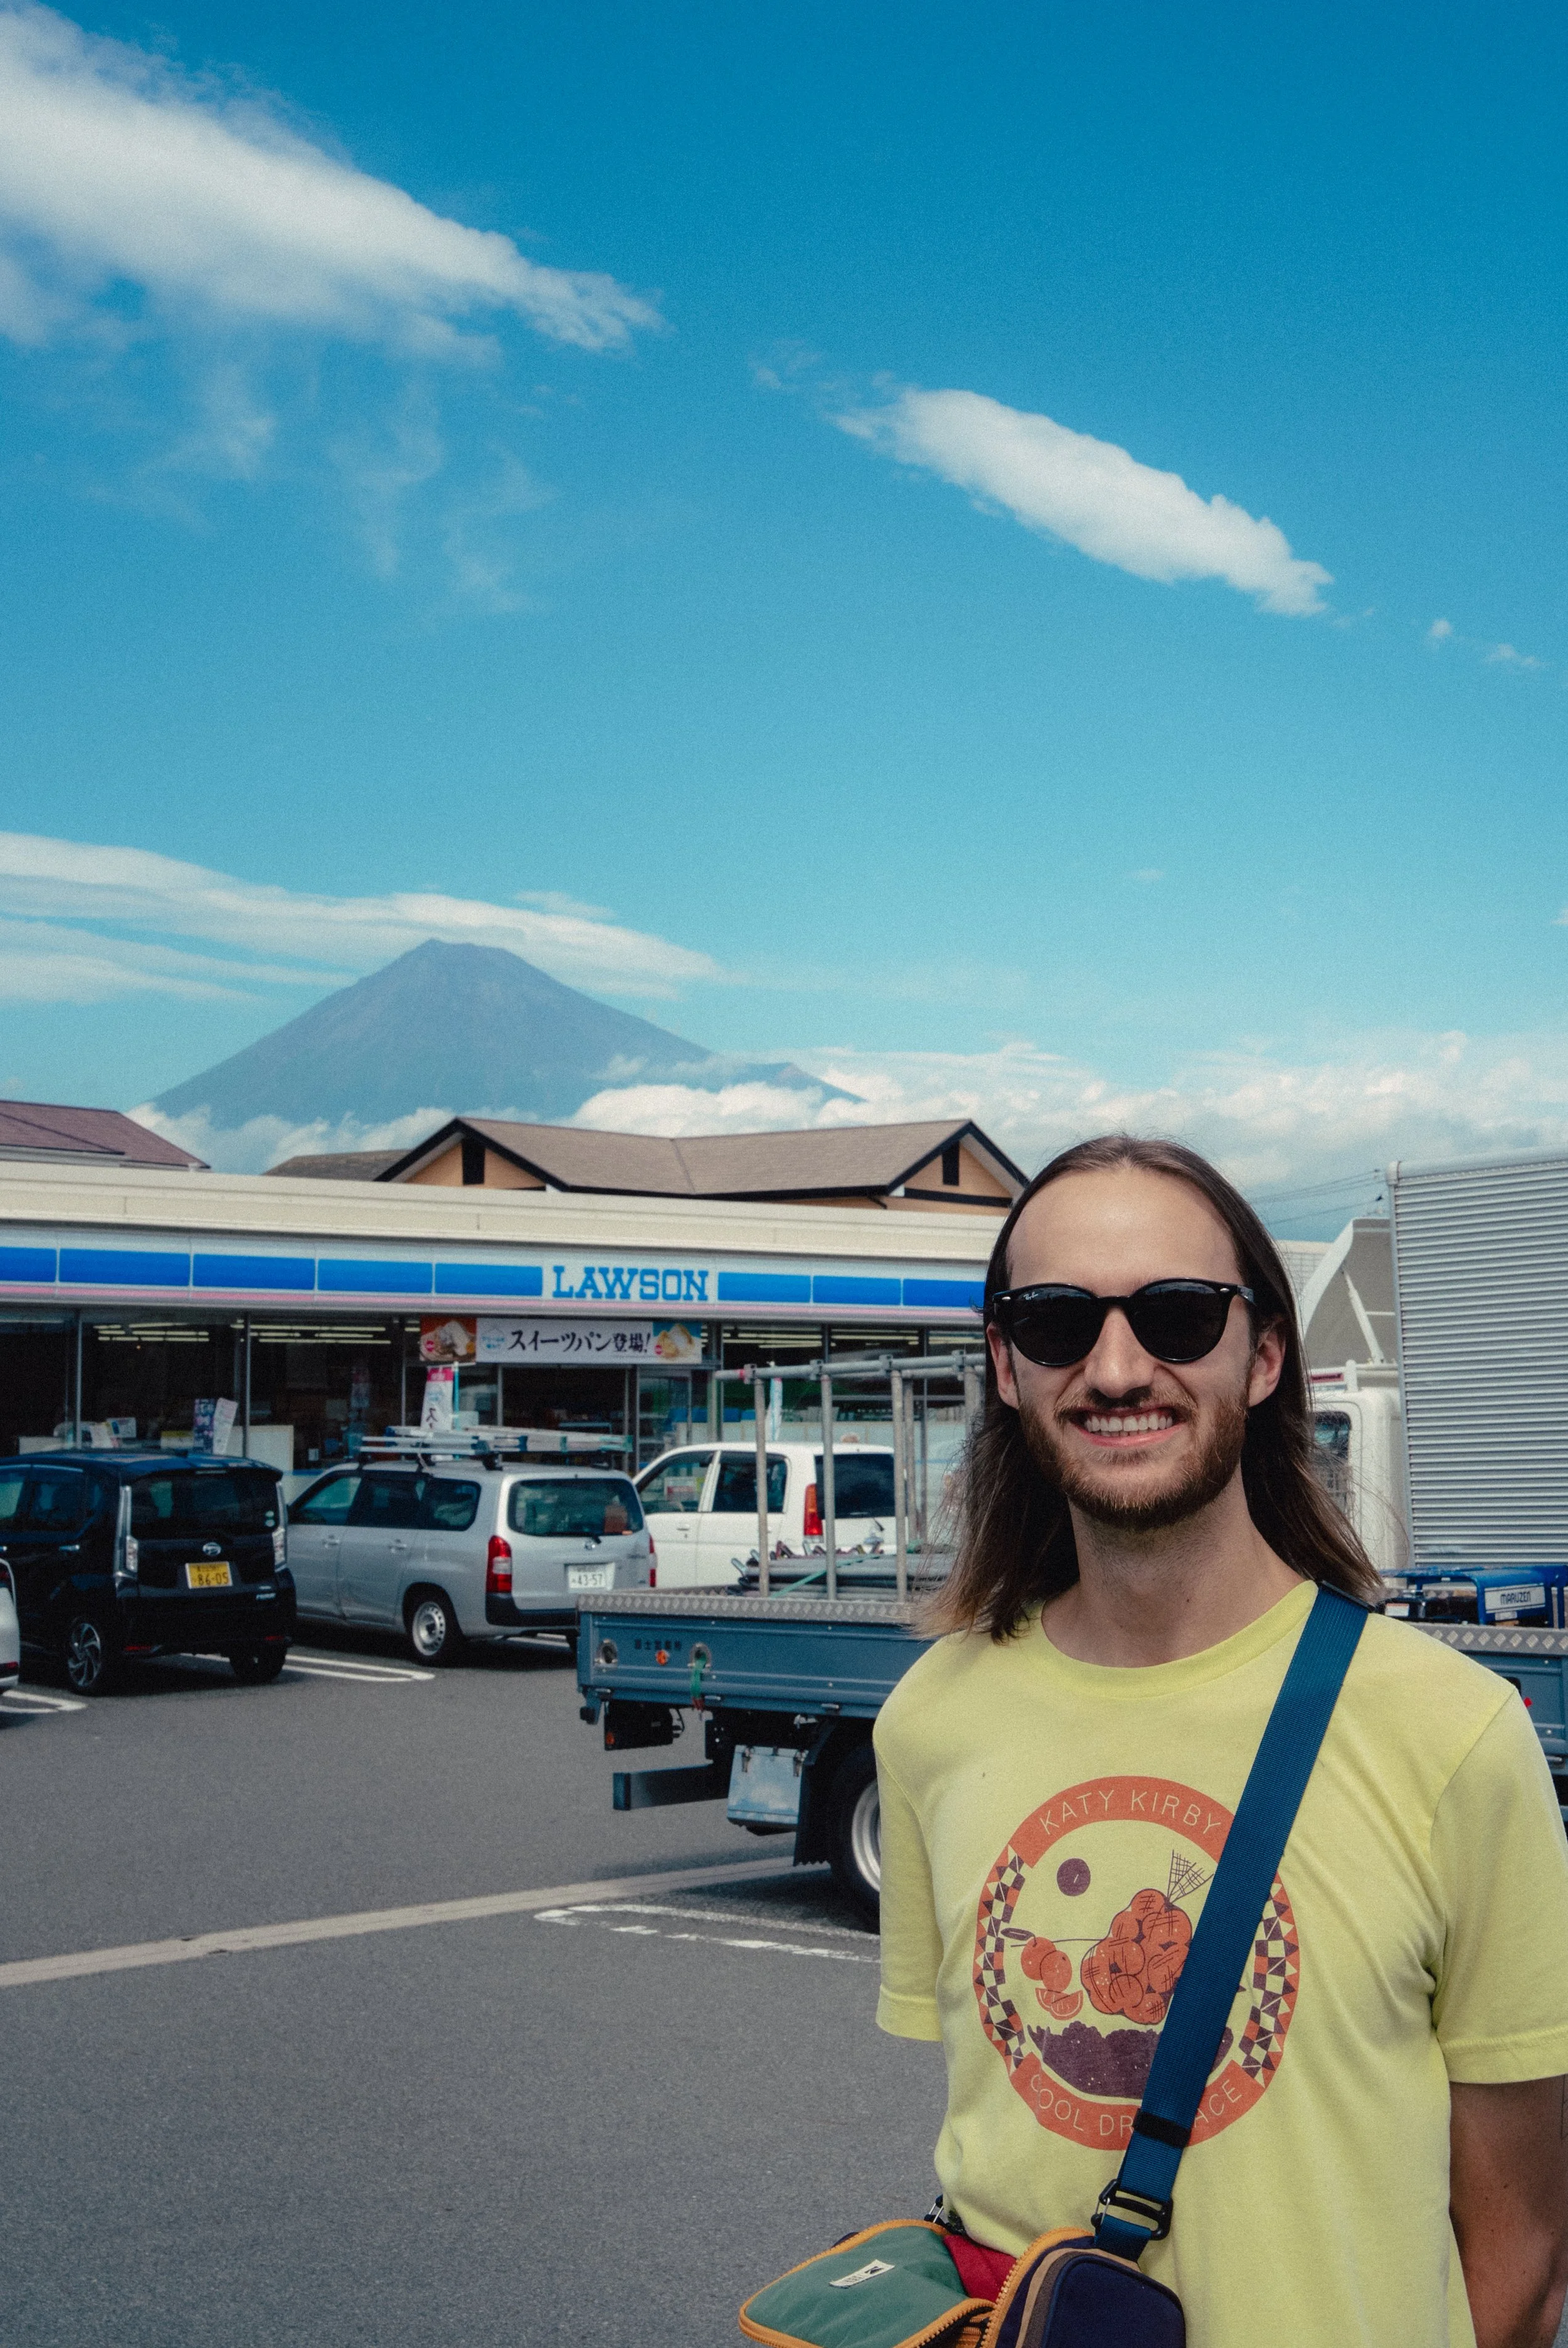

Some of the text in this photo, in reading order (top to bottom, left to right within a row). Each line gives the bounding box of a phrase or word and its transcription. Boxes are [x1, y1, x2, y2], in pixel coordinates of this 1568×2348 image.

[553, 1265, 709, 1300] LAWSON
[1040, 1789, 1221, 1835] KATY KIRBY
[1030, 2074, 1084, 2132] COOL
[1099, 2115, 1133, 2137] DR
